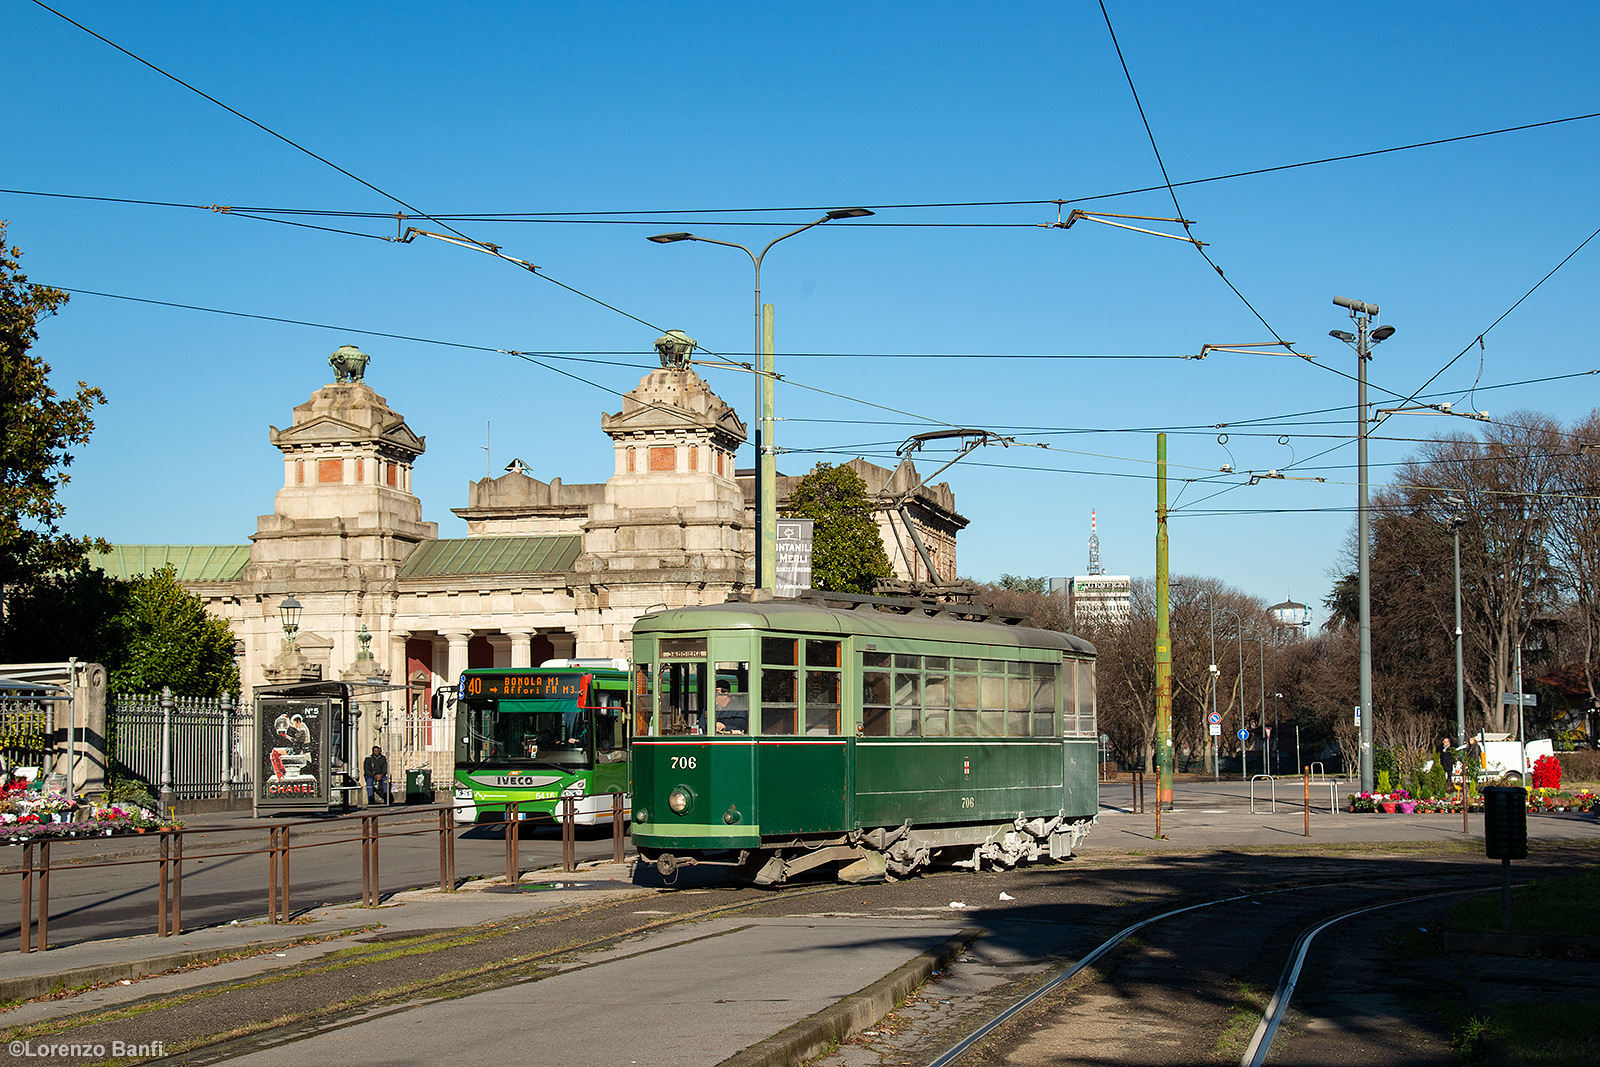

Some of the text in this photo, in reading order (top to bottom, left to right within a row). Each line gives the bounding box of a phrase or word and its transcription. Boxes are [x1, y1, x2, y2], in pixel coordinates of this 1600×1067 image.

[779, 553, 808, 563] MERLI
[468, 677, 482, 695] 40
[504, 677, 559, 686] BONOLA M1
[504, 685, 540, 695] Affori
[563, 685, 575, 694] M3
[670, 756, 697, 770] 706
[496, 776, 534, 785] IVECO
[269, 784, 315, 794] CHANEL
[961, 797, 975, 808] 706
